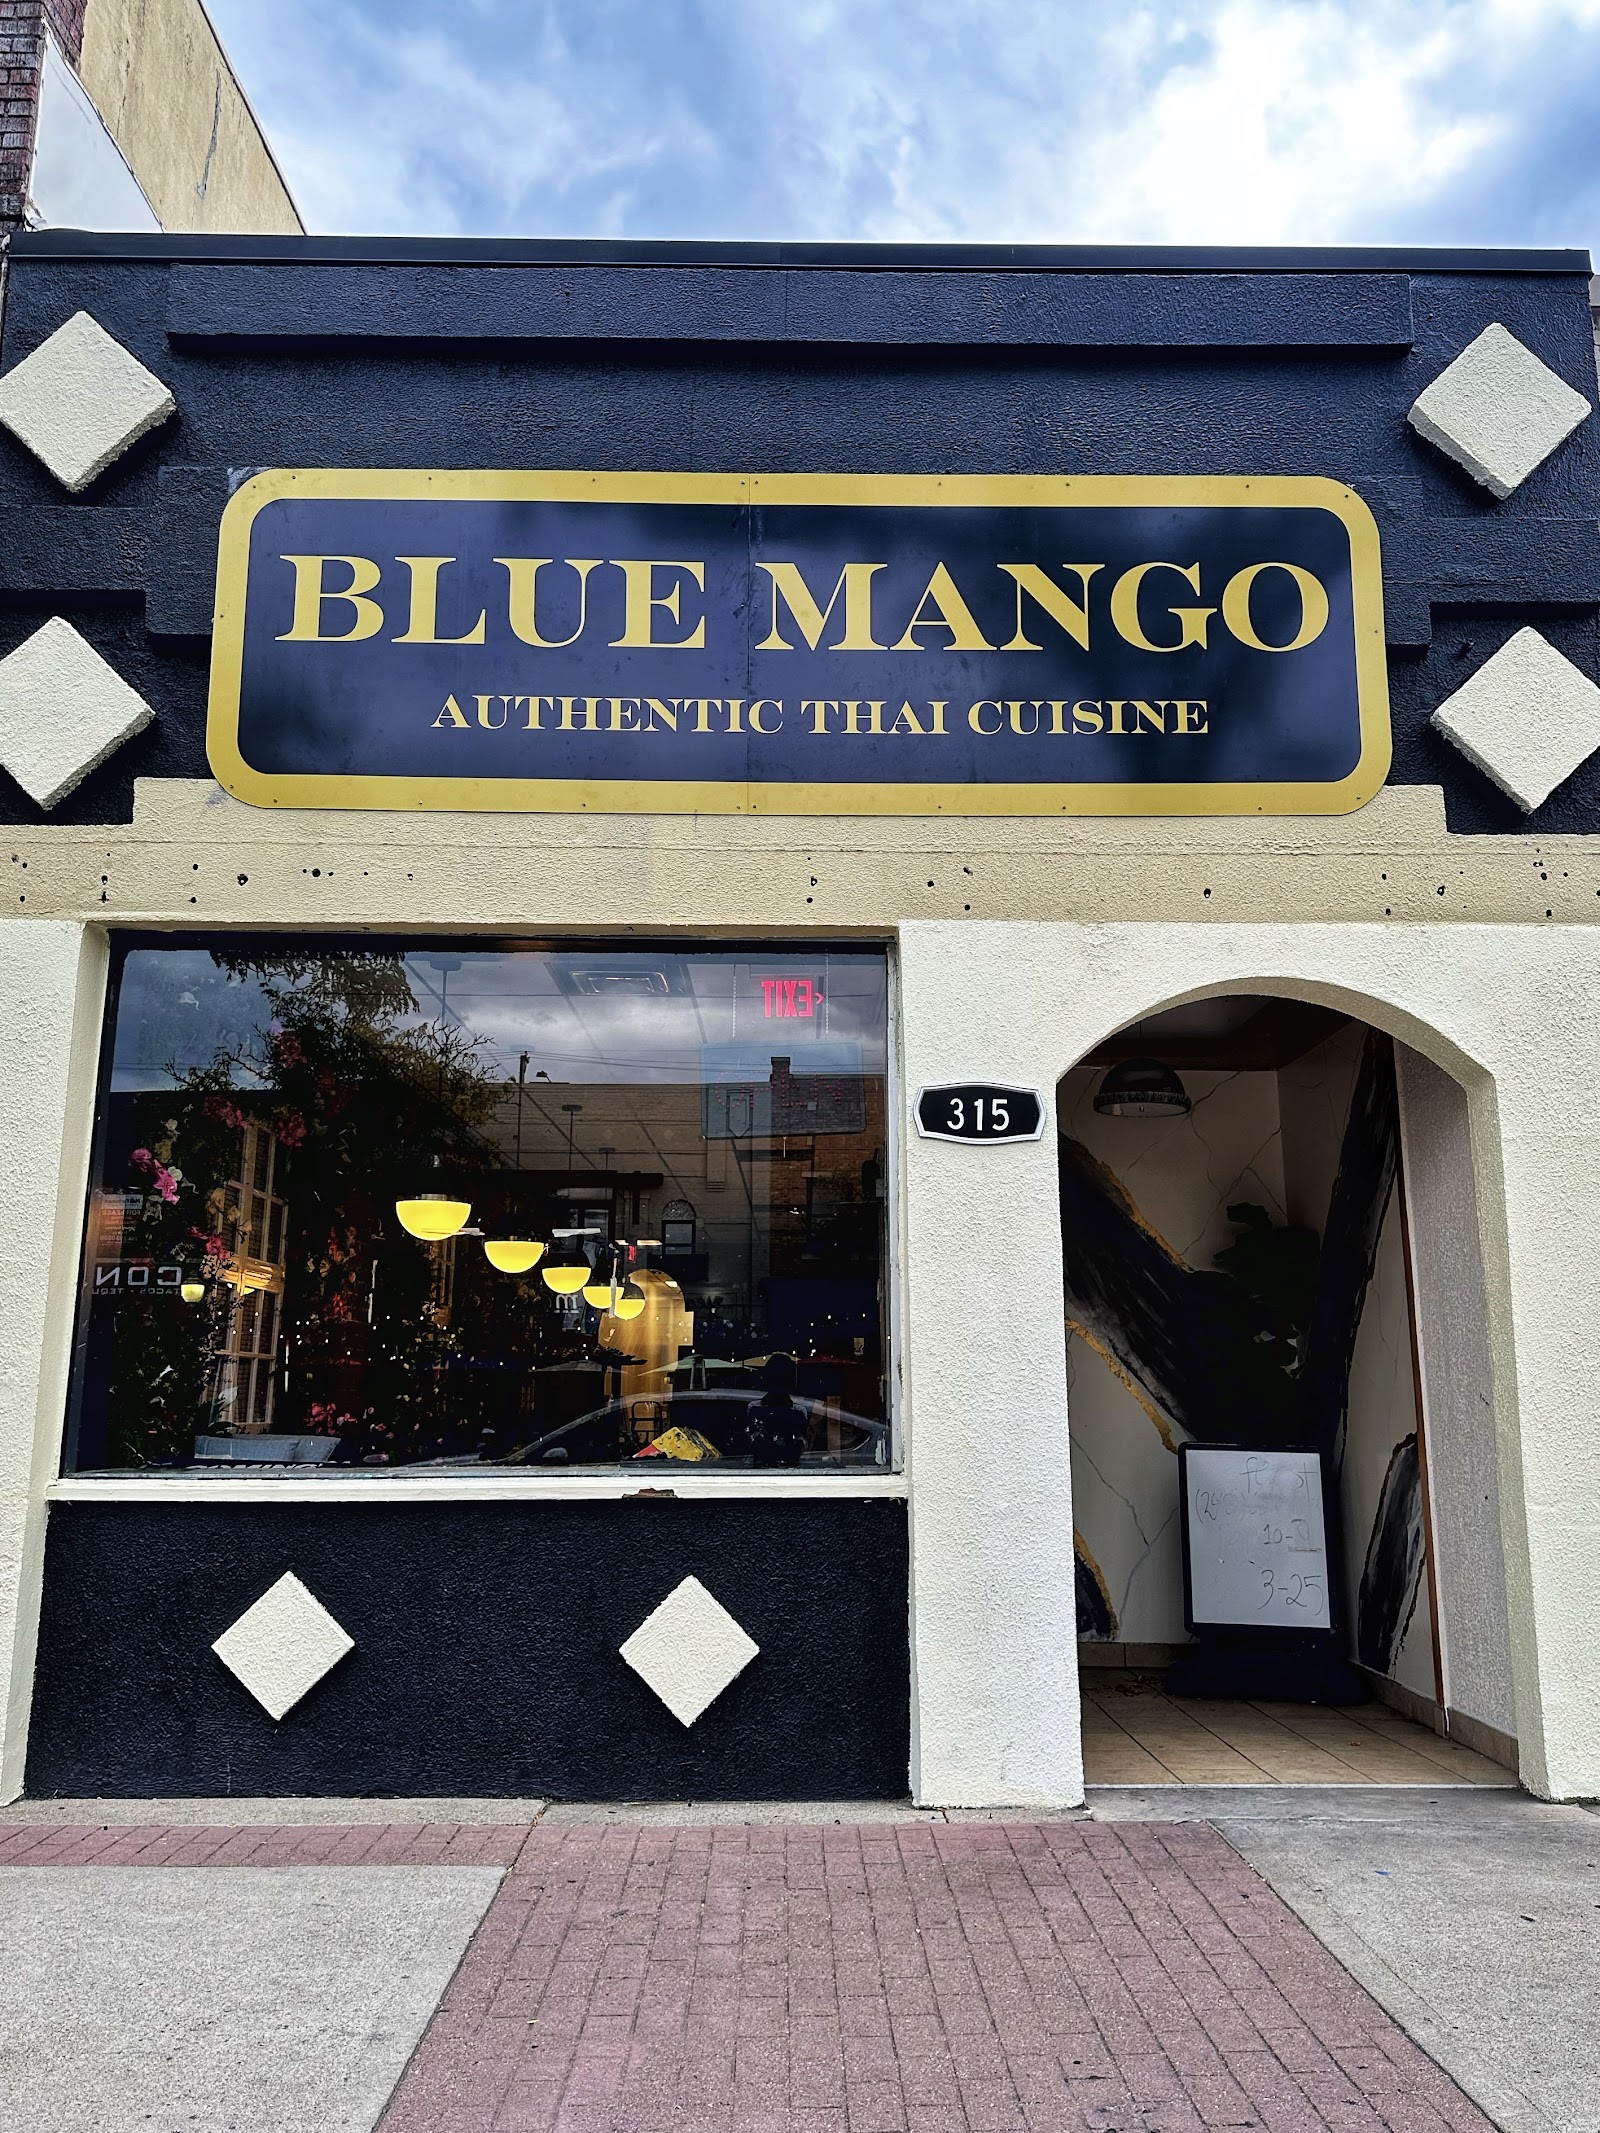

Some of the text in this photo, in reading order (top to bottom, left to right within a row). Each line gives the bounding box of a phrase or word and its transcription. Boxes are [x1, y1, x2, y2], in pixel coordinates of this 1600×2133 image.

[275, 554, 1330, 653] BLUE MANGO
[430, 693, 1209, 735] AUTHENTIC THAI CUISINE
[946, 1098, 1010, 1132] 315
